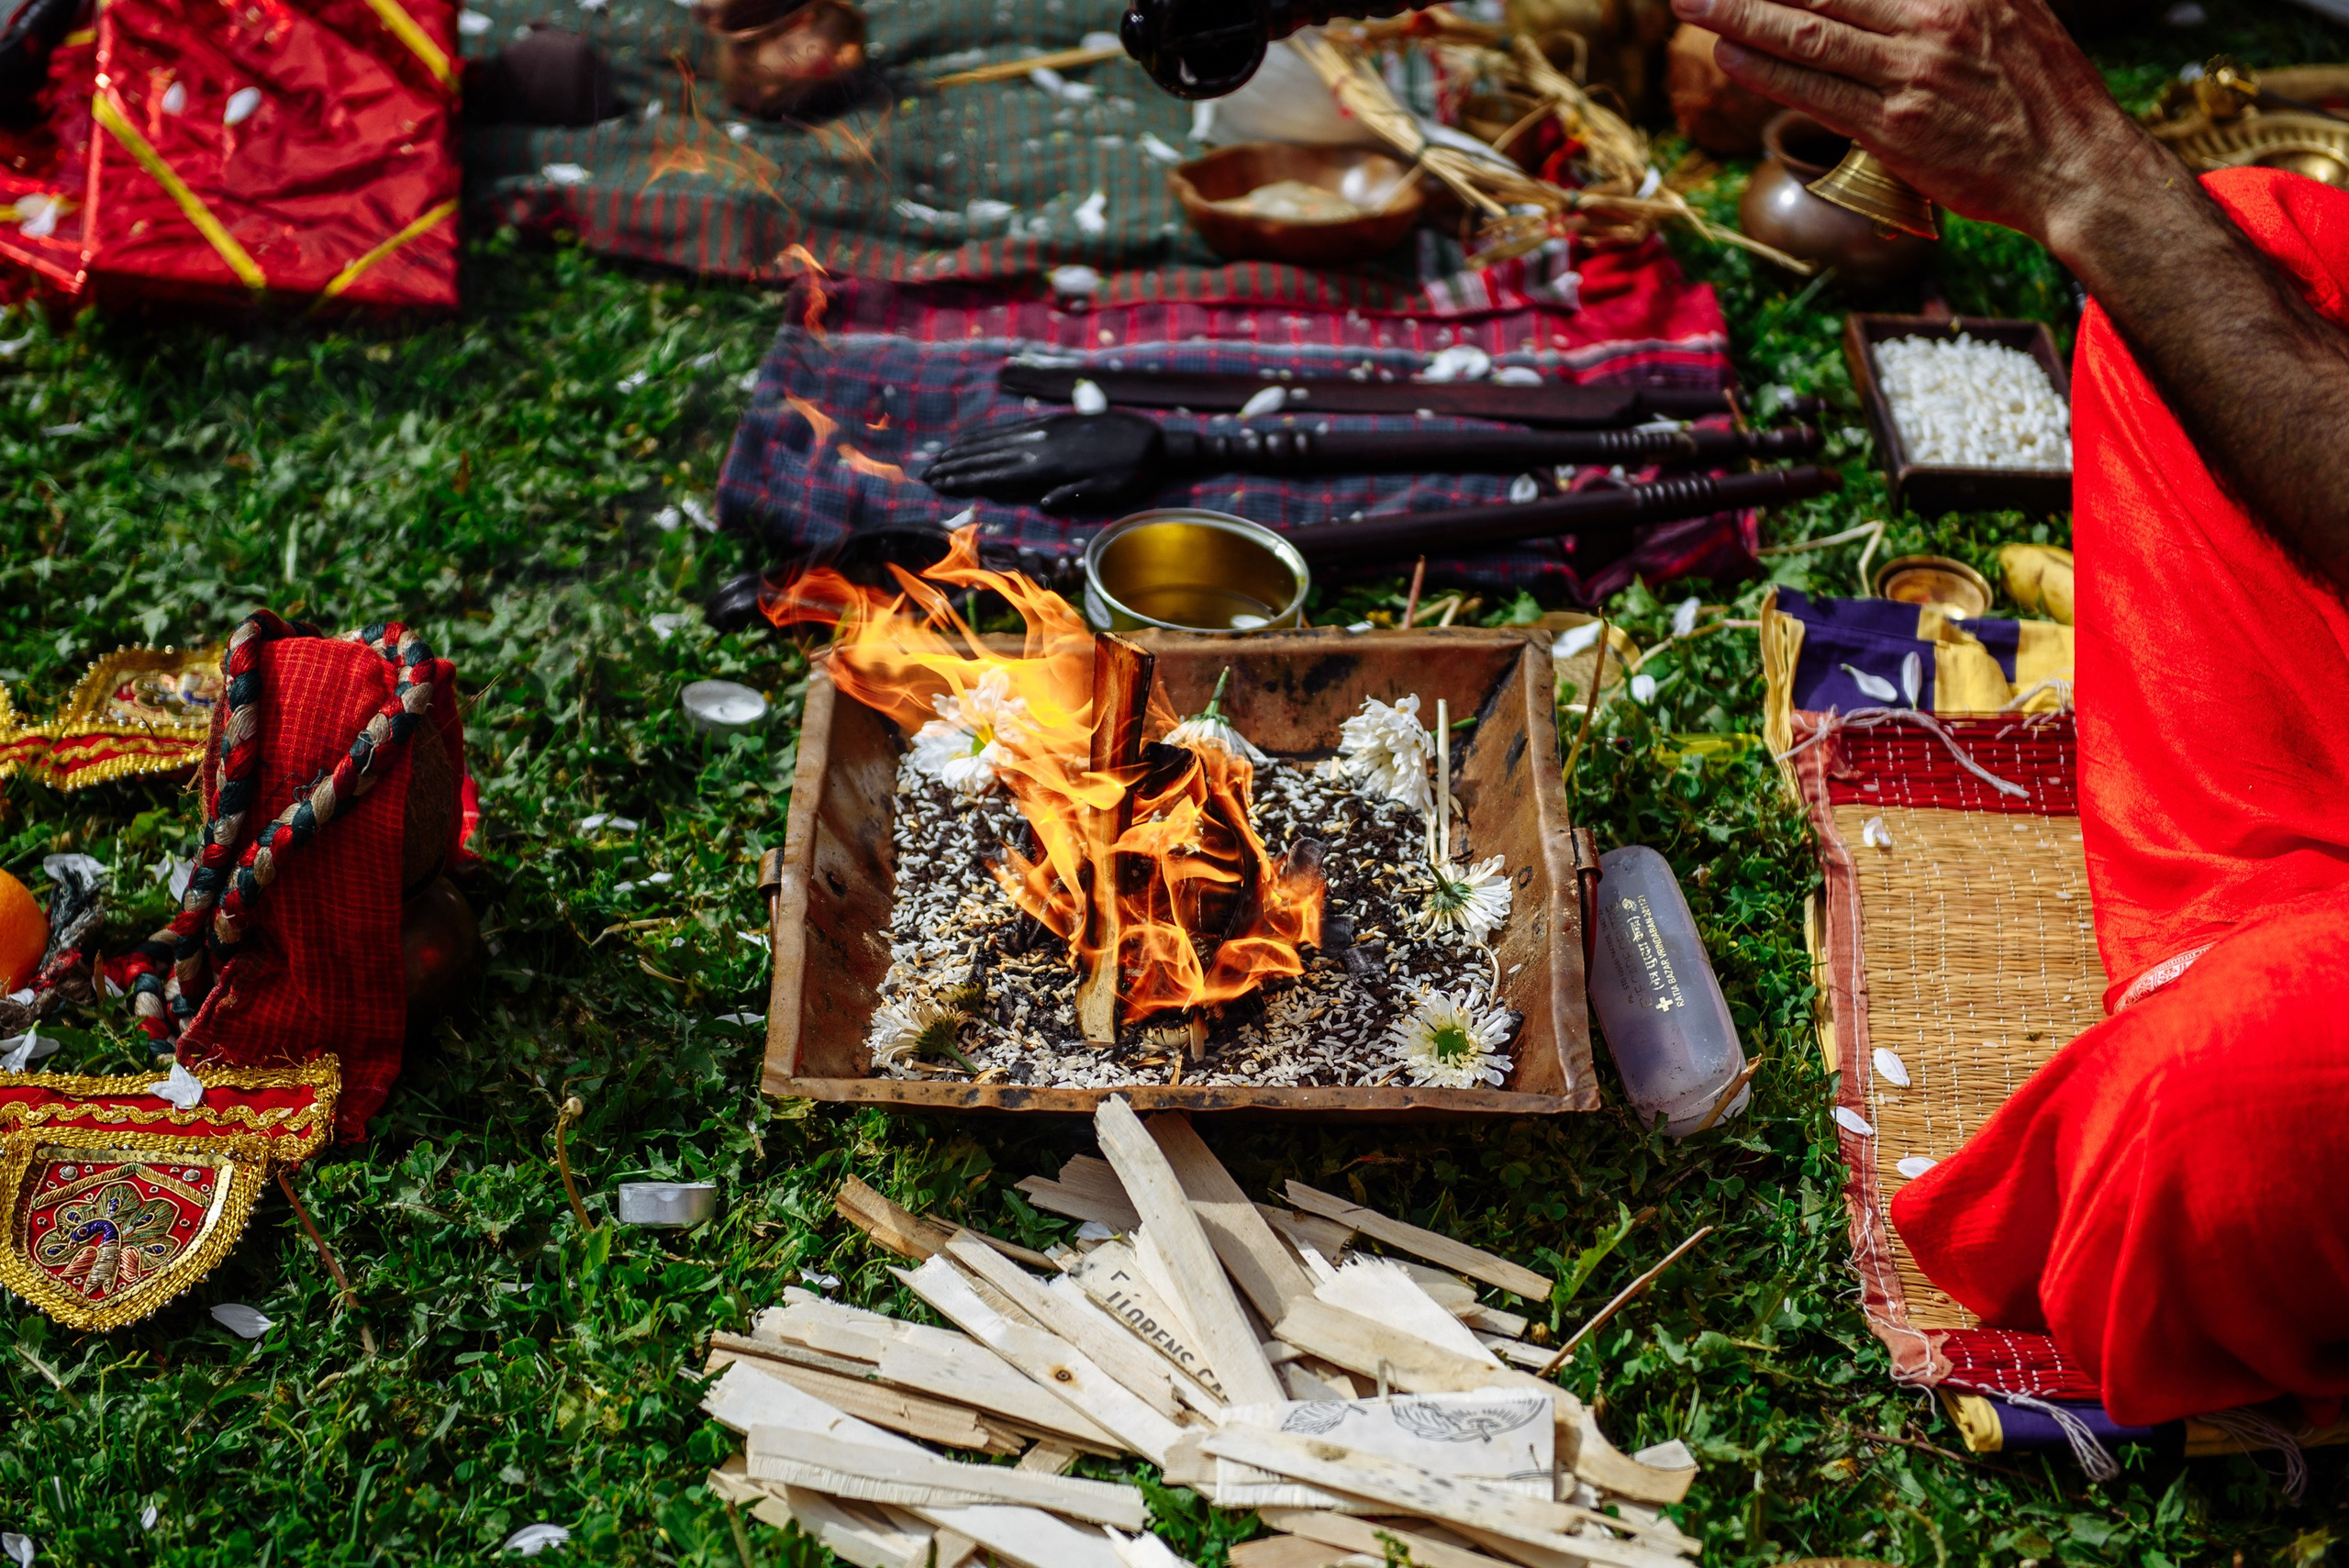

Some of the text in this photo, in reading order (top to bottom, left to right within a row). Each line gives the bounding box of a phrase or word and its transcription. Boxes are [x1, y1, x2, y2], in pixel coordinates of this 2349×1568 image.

[1621, 951, 1641, 984] CARE
[1661, 957, 1677, 984] BAZAR
[1633, 985, 1653, 1007] EYE
[1671, 984, 1686, 1008] RATIA
